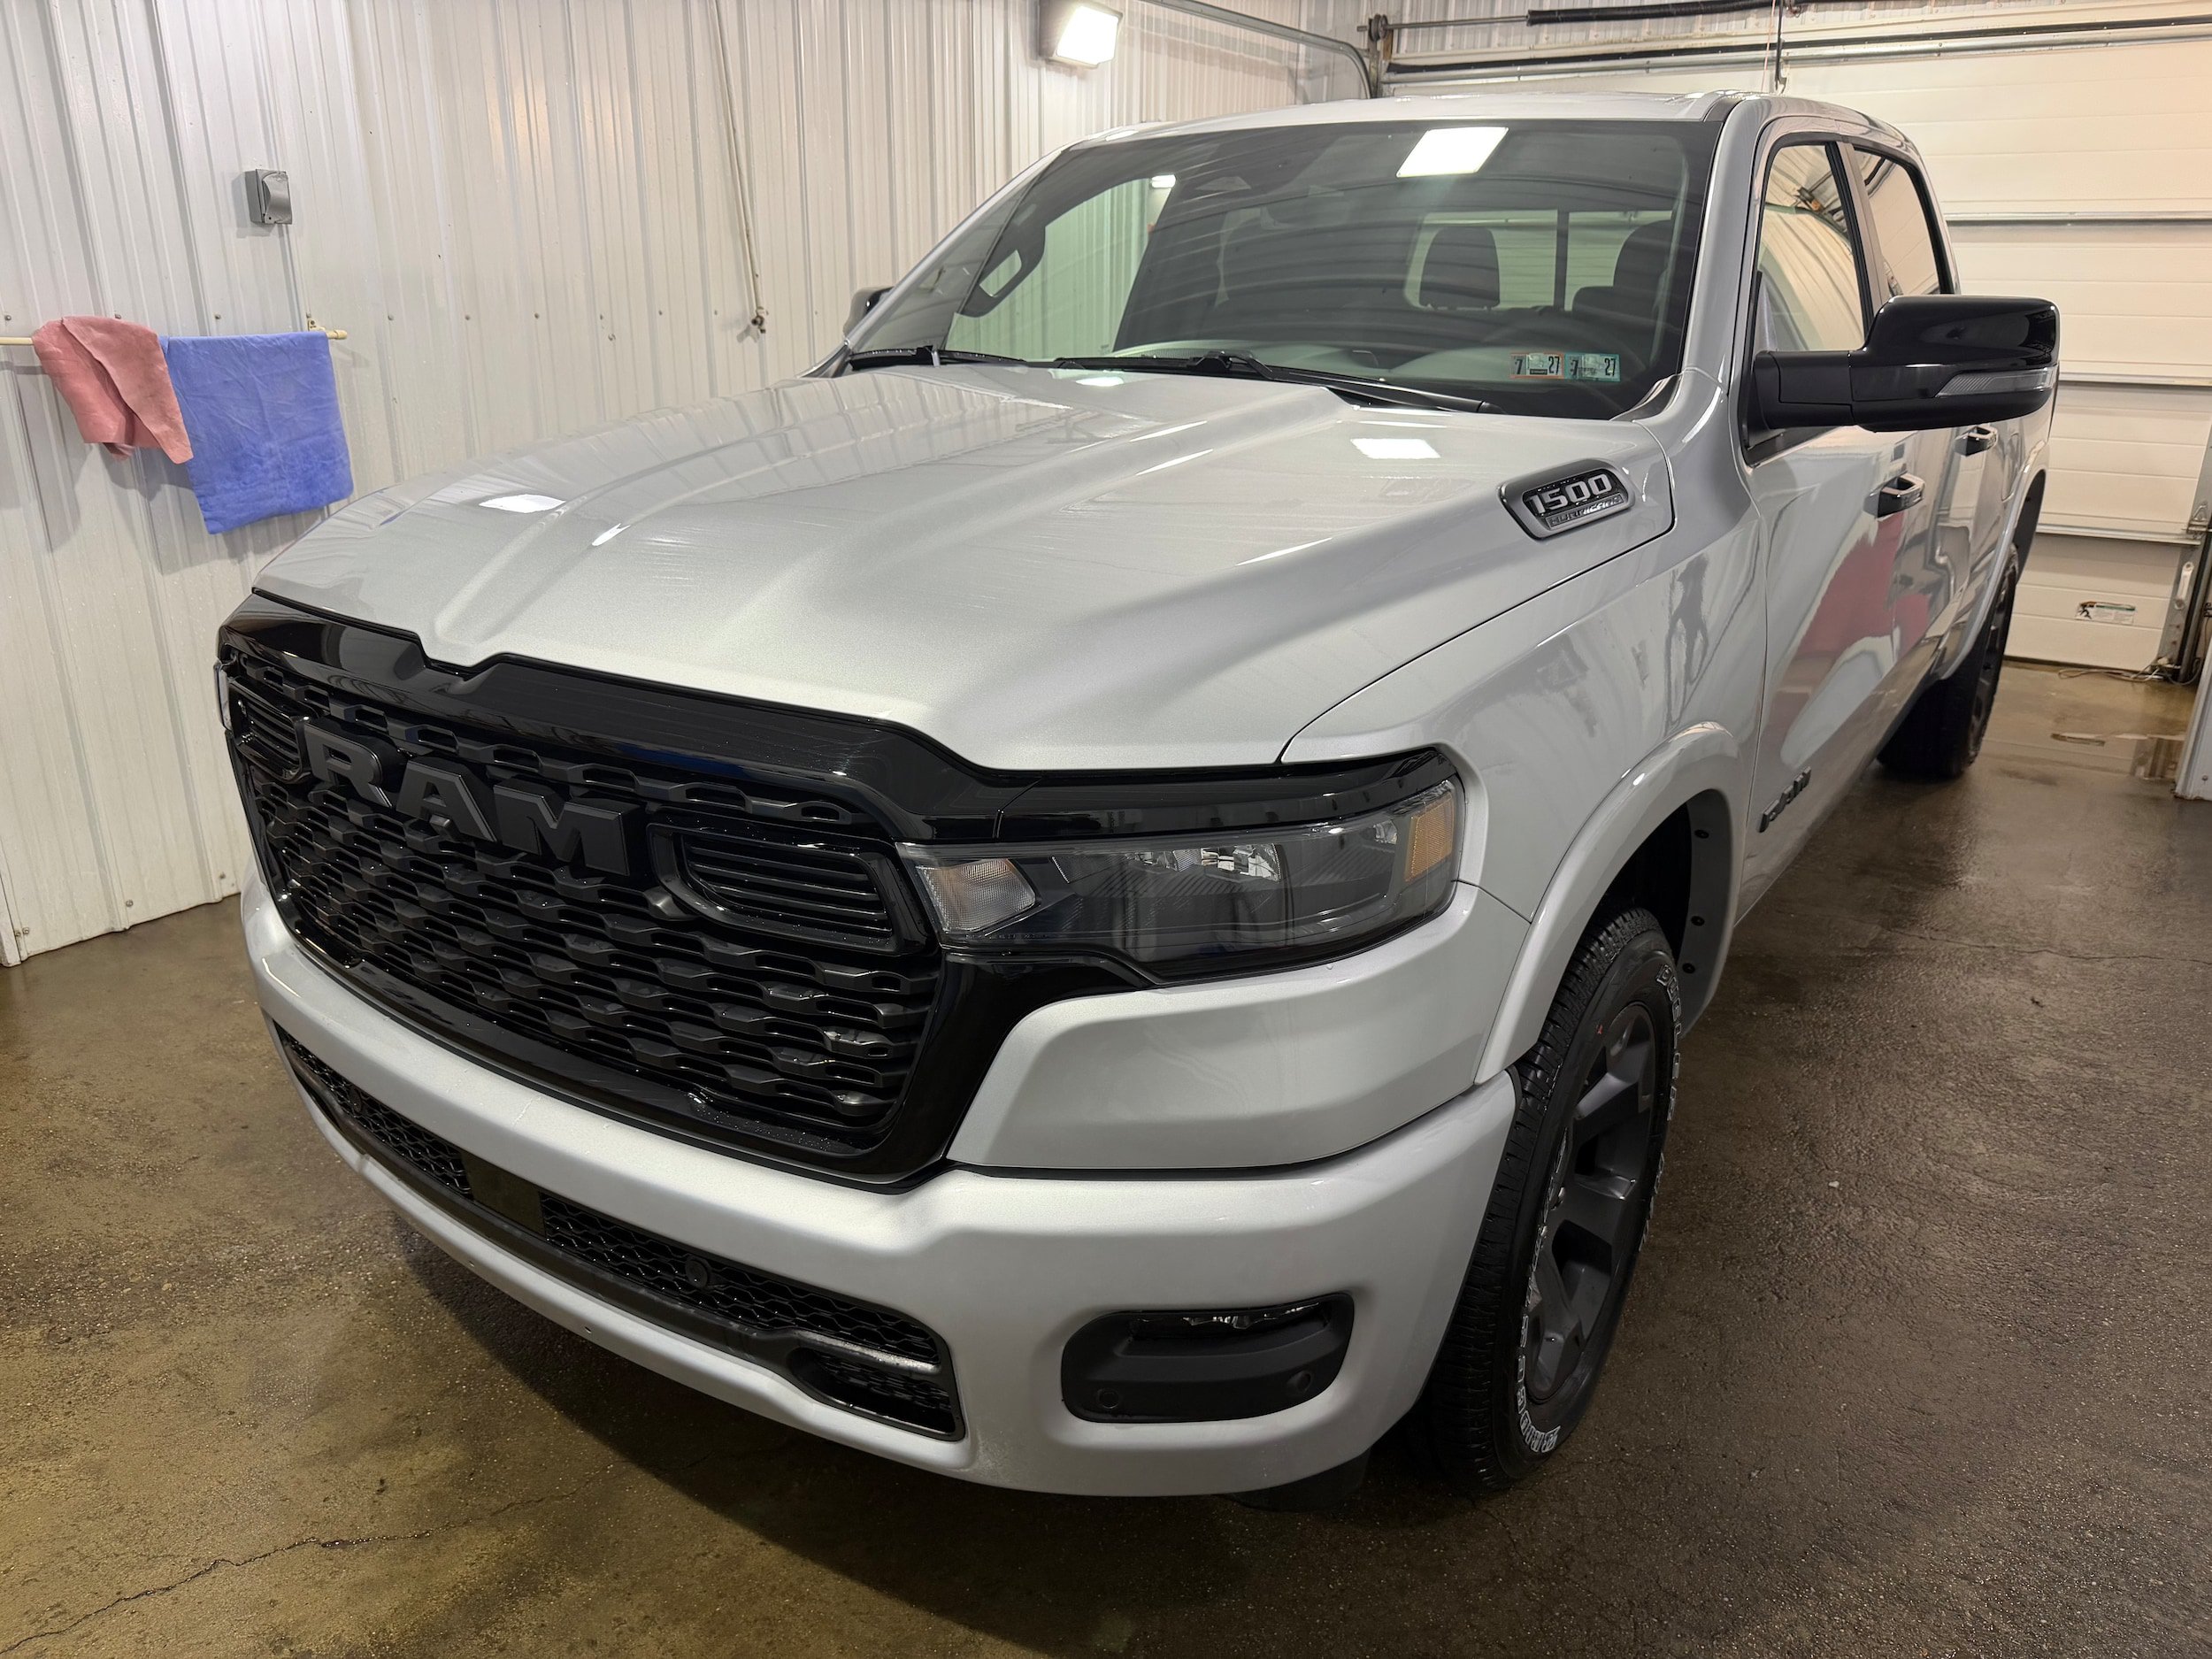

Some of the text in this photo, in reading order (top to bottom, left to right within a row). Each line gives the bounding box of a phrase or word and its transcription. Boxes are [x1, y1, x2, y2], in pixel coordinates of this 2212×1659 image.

[1548, 356, 1560, 374] 27
[1604, 357, 1617, 377] 27
[1526, 473, 1612, 513] 1500
[304, 719, 630, 876] RAM
